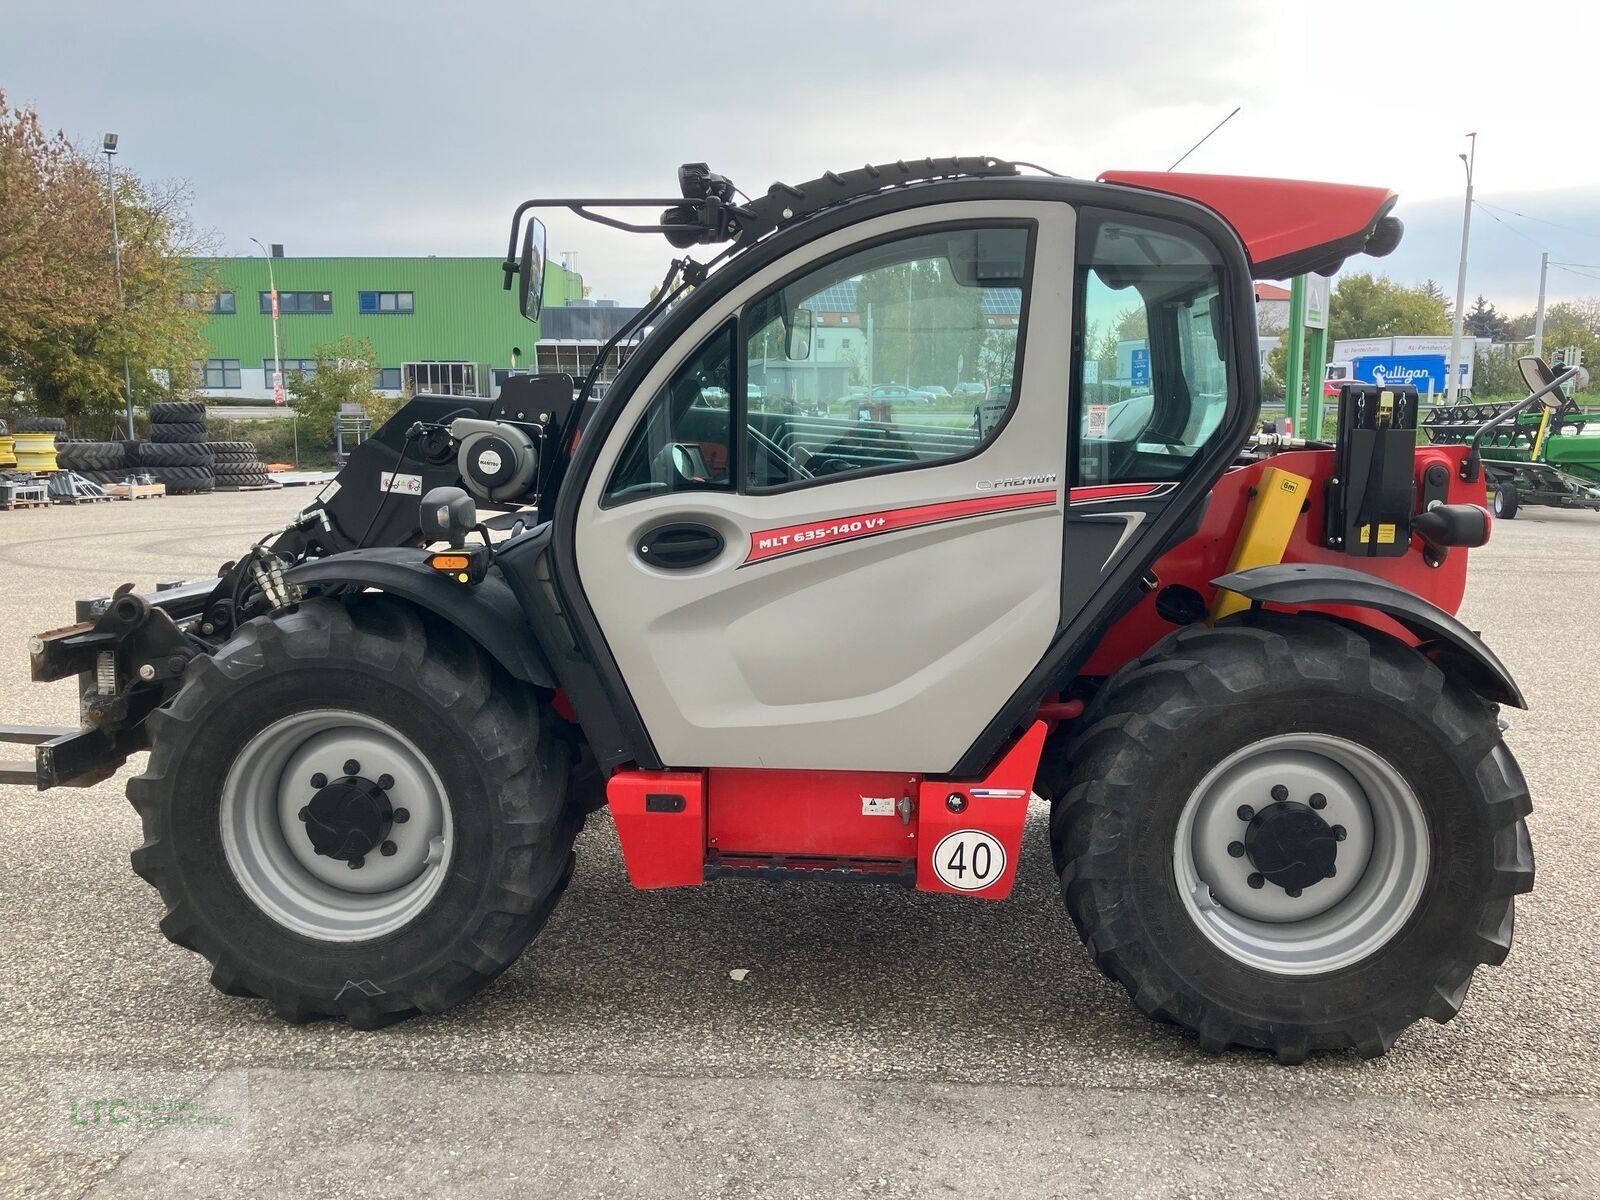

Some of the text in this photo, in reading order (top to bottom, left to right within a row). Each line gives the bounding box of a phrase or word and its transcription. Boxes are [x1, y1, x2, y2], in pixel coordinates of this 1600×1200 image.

[1372, 364, 1429, 383] Culligan
[994, 473, 1056, 489] PREMIUM
[1283, 482, 1295, 491] 6m
[759, 517, 886, 550] MLT 635-140 V+
[947, 841, 991, 879] 40
